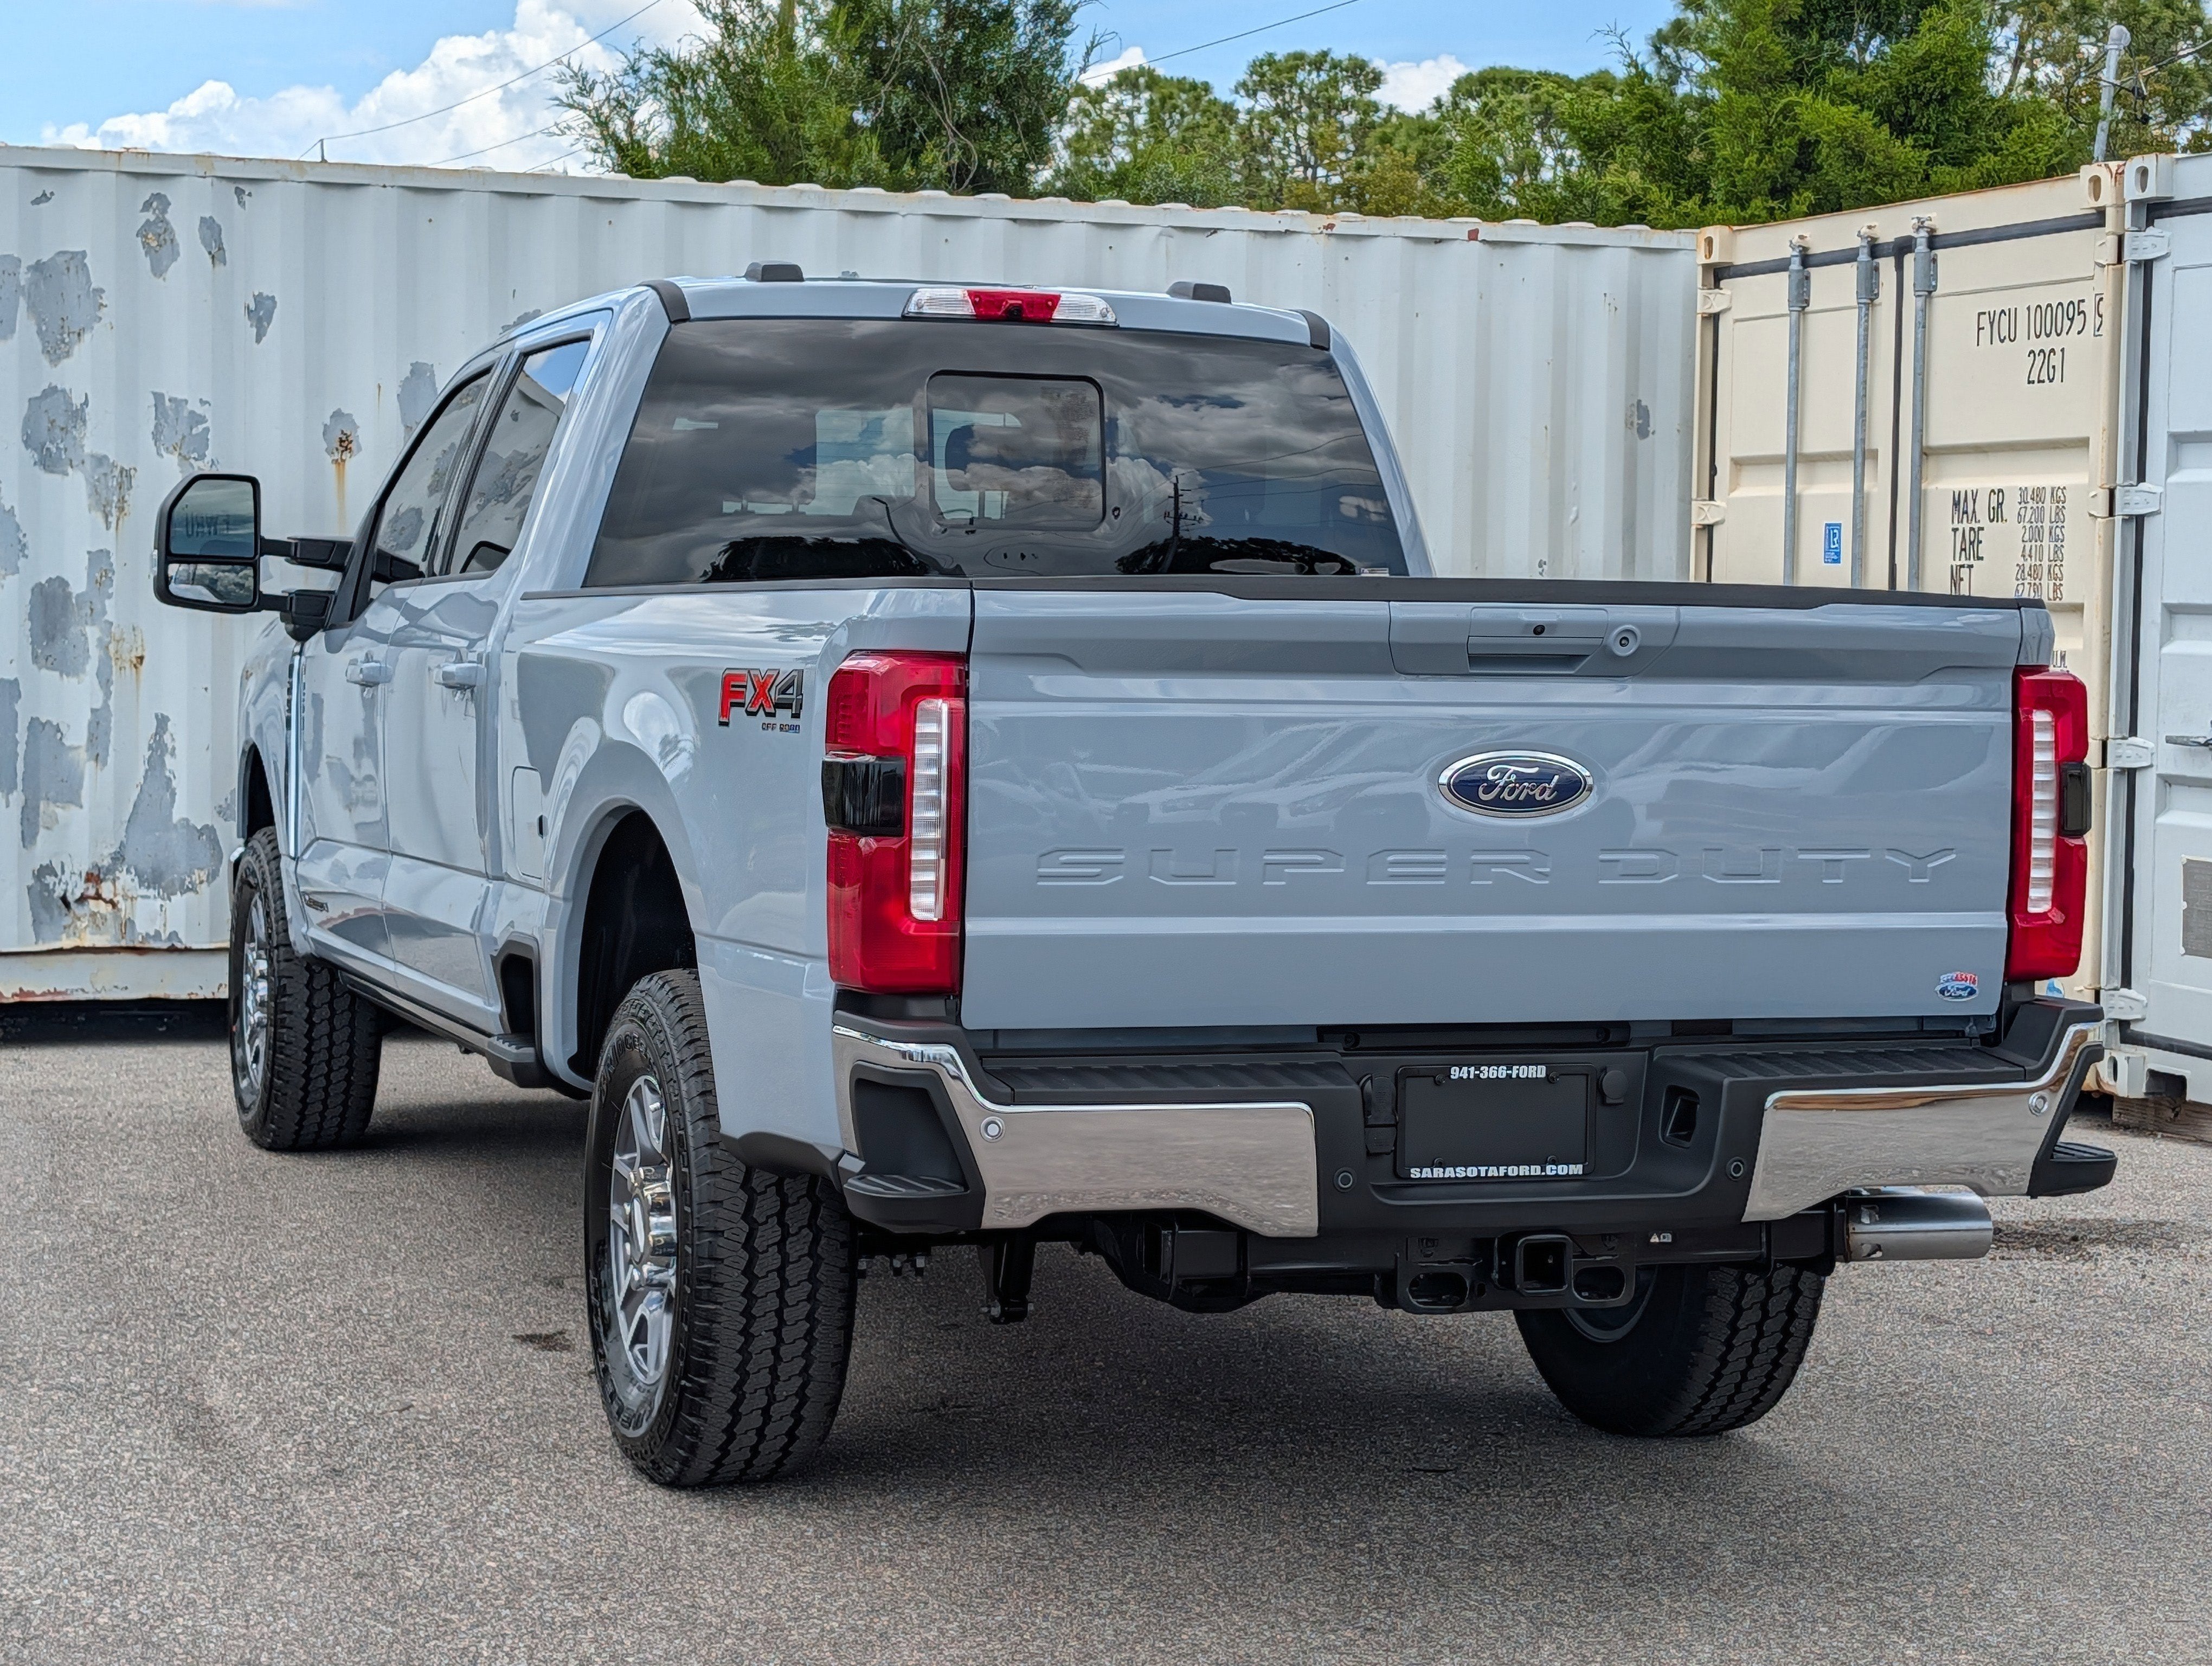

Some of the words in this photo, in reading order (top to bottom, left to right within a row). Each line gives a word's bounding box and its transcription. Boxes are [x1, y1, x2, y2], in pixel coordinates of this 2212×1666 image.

[1977, 307, 2017, 347] FYCU
[2027, 299, 2086, 340] 100095
[2027, 347, 2065, 385] 22G1
[2050, 486, 2066, 504] KGS
[1951, 488, 1980, 524] MAX.
[1988, 488, 2008, 523] GR.
[2049, 505, 2066, 524] LBS
[2049, 525, 2065, 542] KGS
[1951, 526, 1984, 561] TARE
[2048, 544, 2064, 562] LBS
[2047, 563, 2063, 581] KGS
[2047, 582, 2063, 601] LBS
[718, 668, 804, 726] FX4
[762, 722, 777, 731] OFF
[779, 723, 800, 733] ROAD
[1478, 765, 1559, 801] Ford
[1038, 849, 1551, 885] SUPER
[1599, 848, 1956, 884] DUTY
[1450, 1065, 1546, 1080] 941-366-FORD
[1410, 1164, 1583, 1178] SARASOTAFORD.COM
